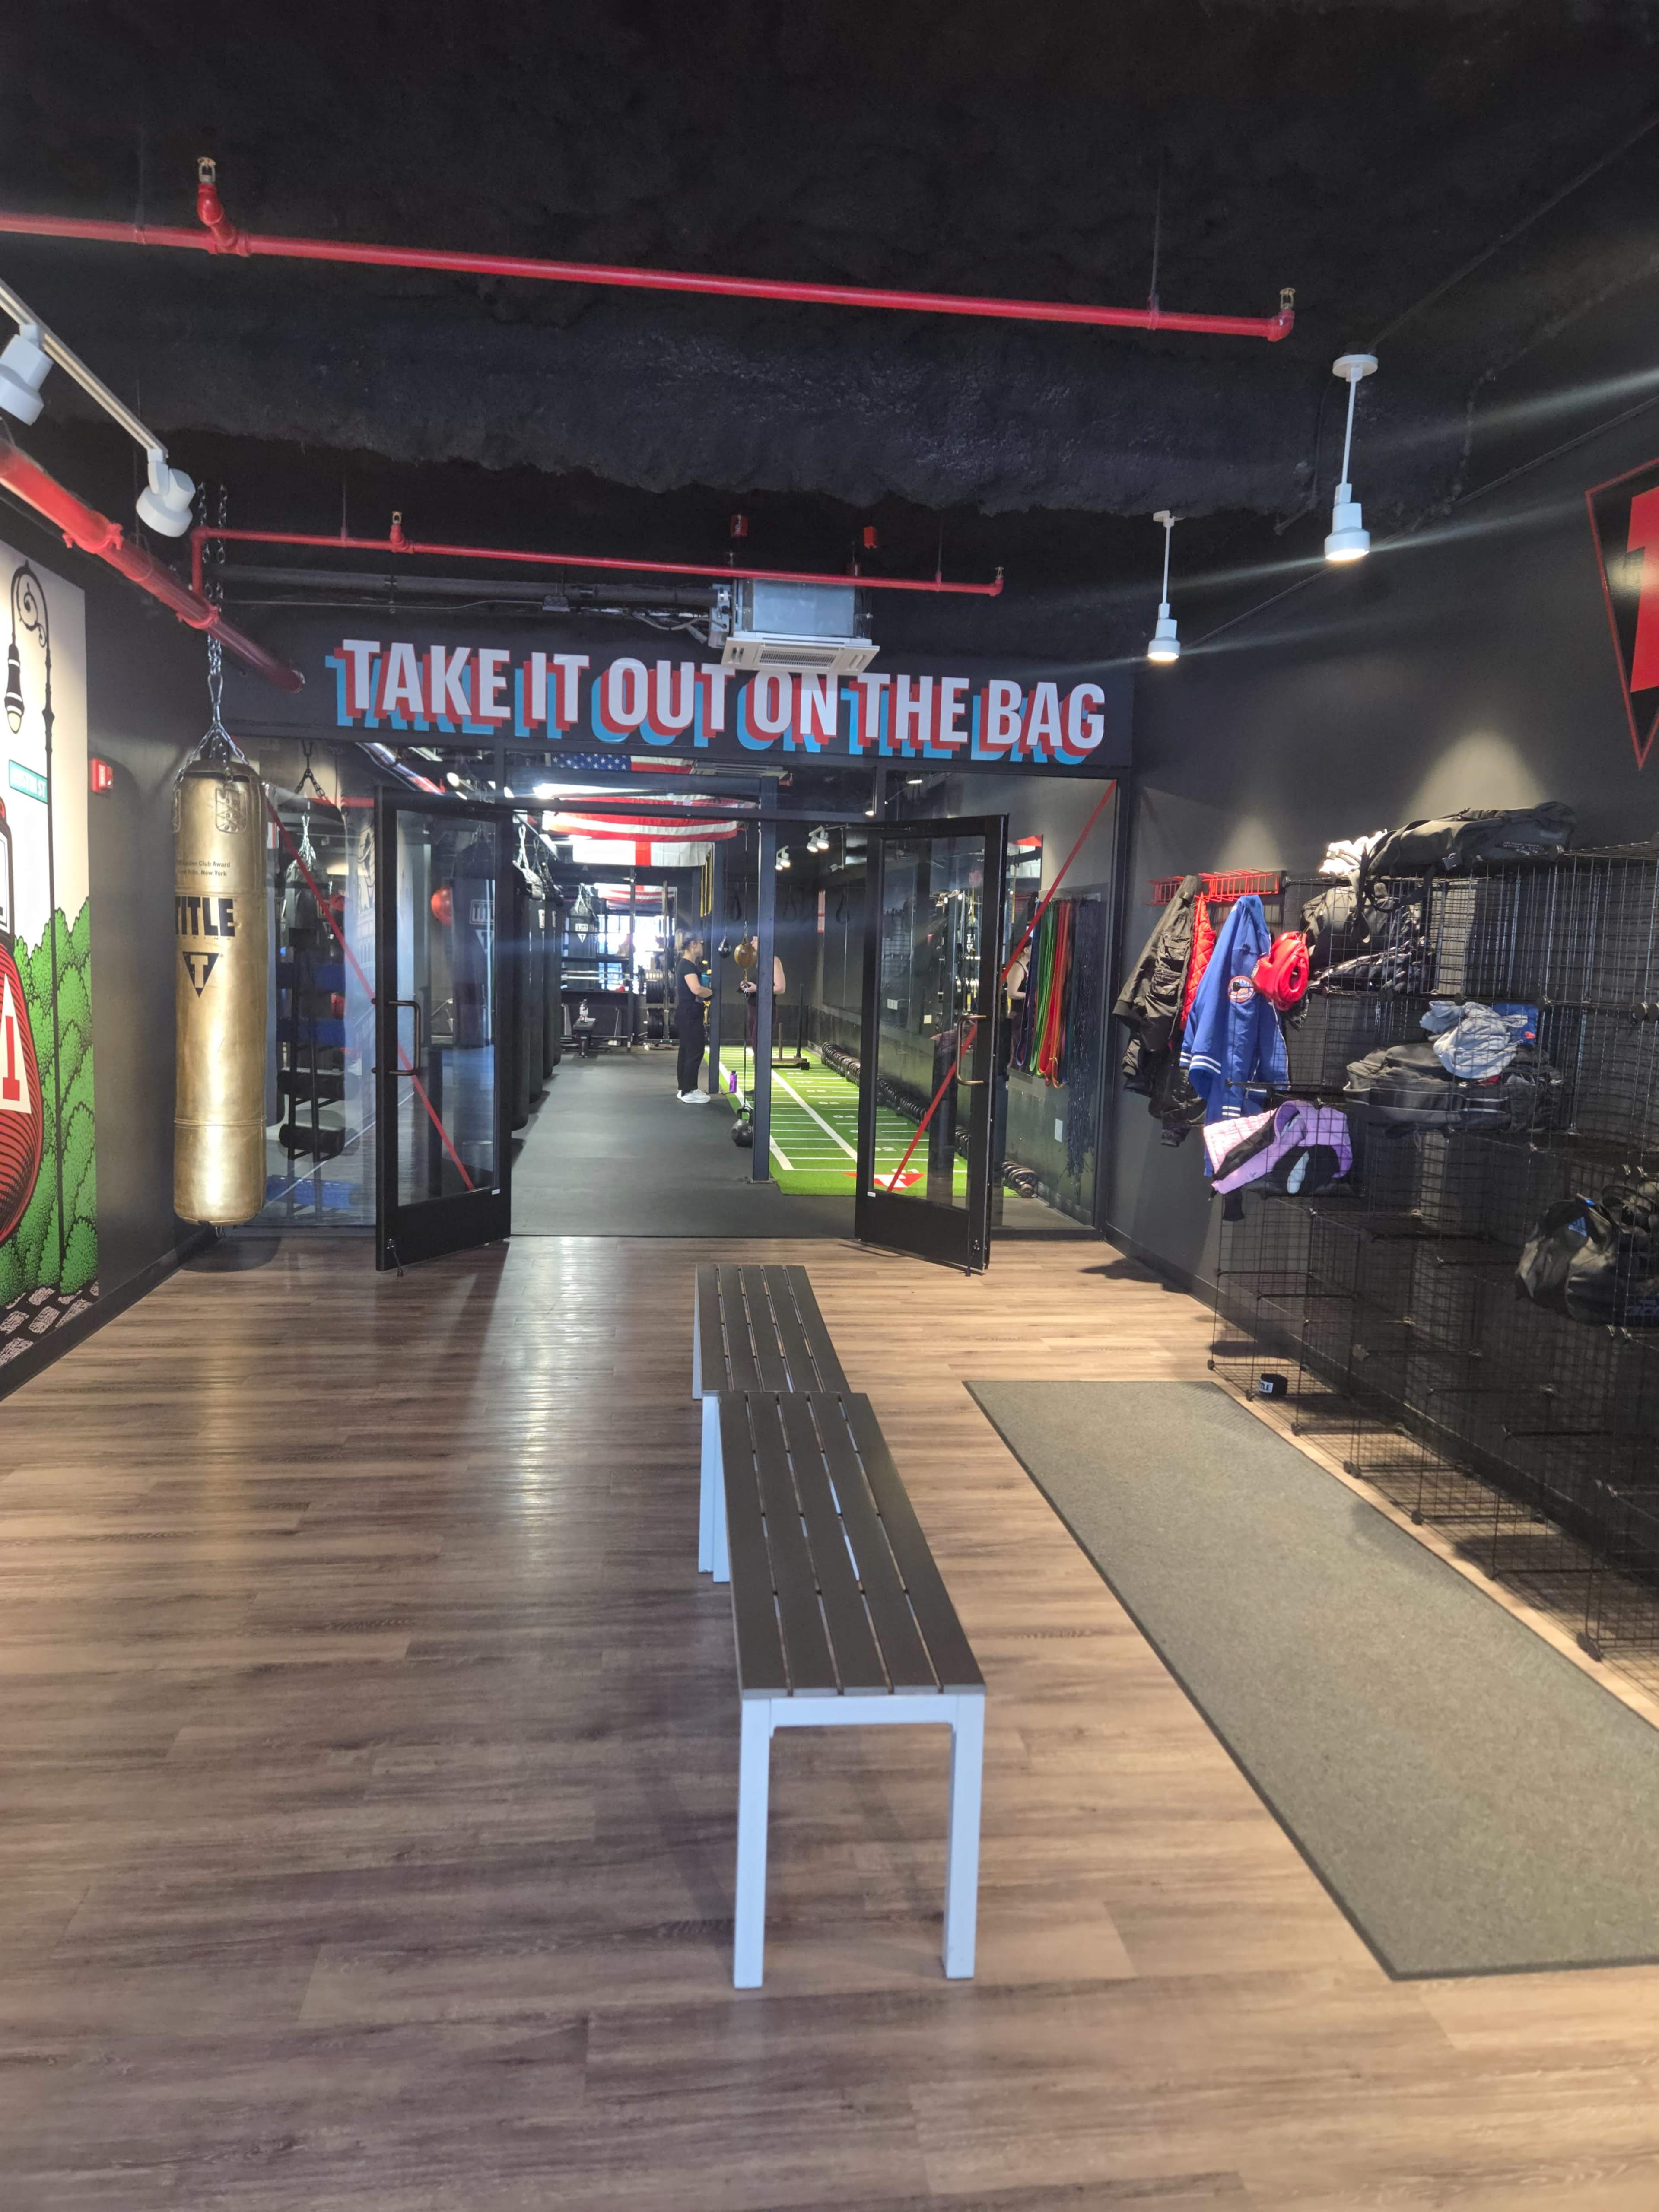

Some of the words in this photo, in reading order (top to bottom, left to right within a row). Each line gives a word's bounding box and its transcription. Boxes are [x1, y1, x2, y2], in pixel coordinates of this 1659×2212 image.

[335, 639, 511, 727] TAKE
[524, 652, 589, 731] IT
[601, 658, 735, 737] OUT
[746, 670, 838, 744] ON
[850, 672, 969, 750] THE
[980, 680, 1105, 756] BAG
[190, 955, 208, 988] T
